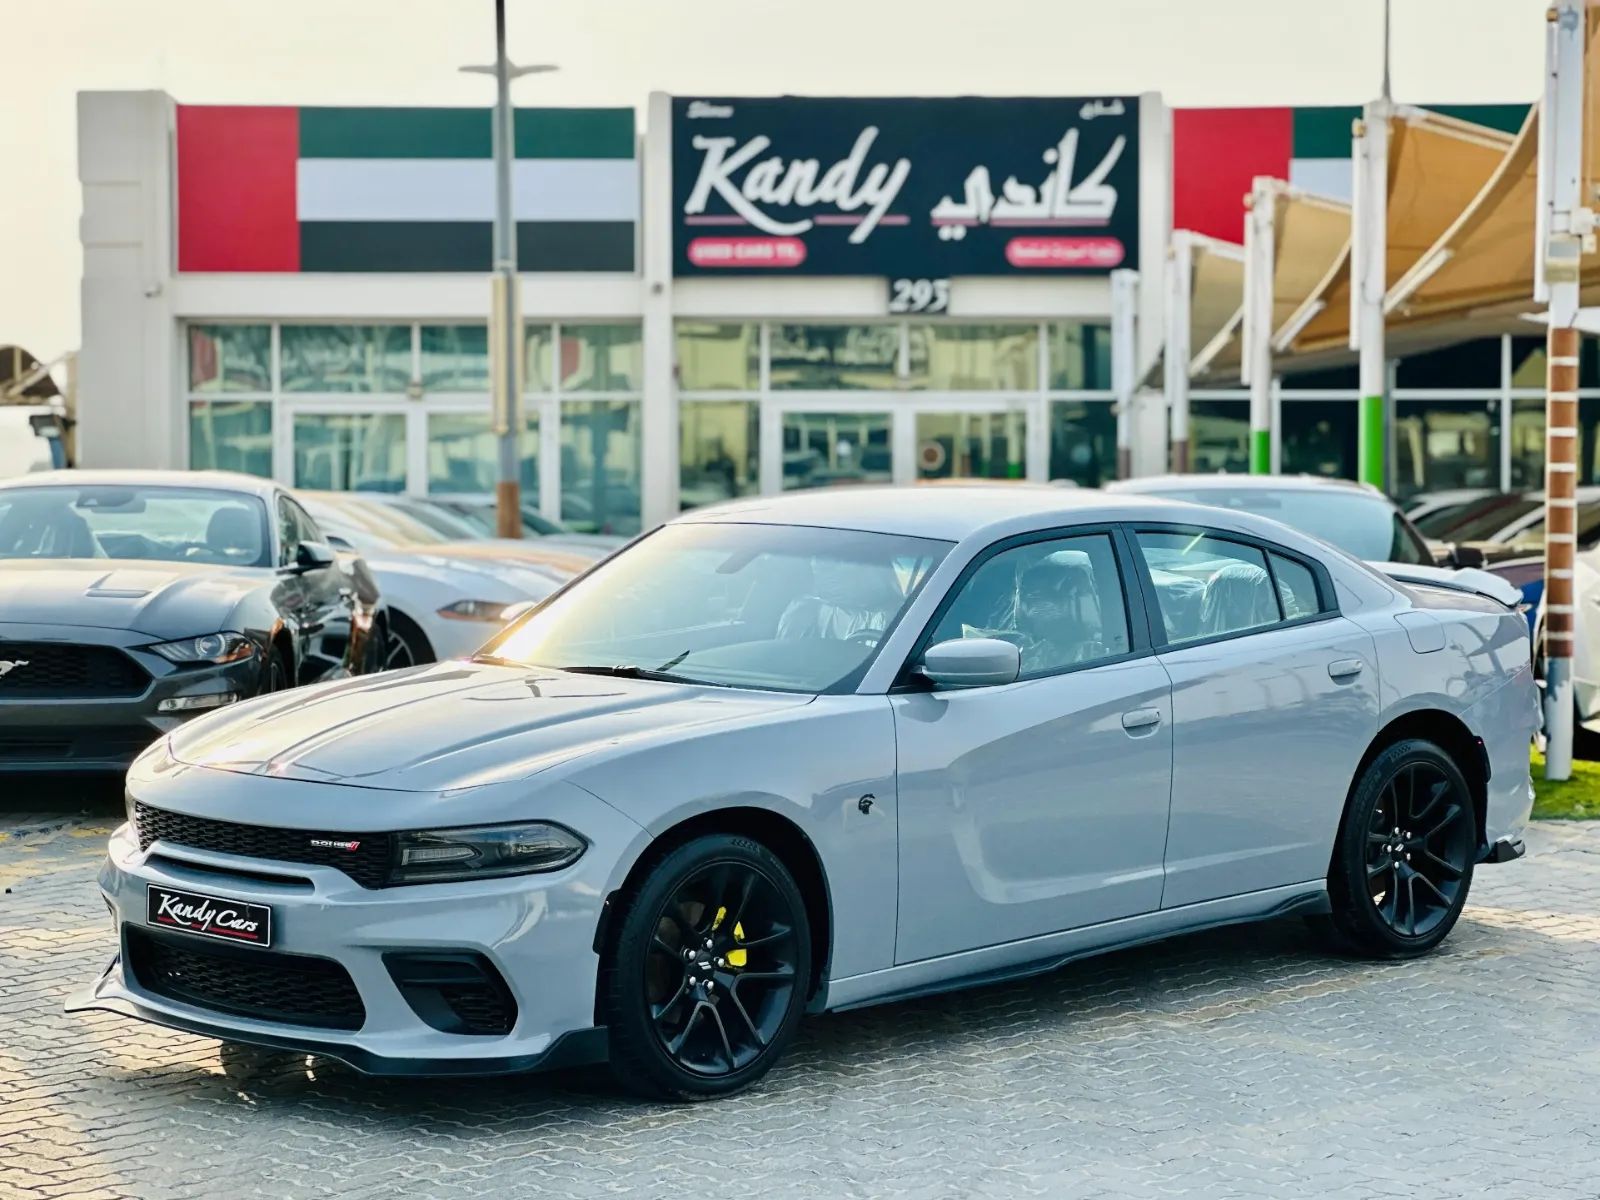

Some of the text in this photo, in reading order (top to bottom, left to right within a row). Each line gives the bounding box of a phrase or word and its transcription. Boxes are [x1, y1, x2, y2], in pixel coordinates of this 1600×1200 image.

[685, 126, 911, 243] Kandy
[931, 128, 1126, 240] كاندي
[890, 278, 949, 312] 295
[158, 893, 259, 932] Kandy Cars
